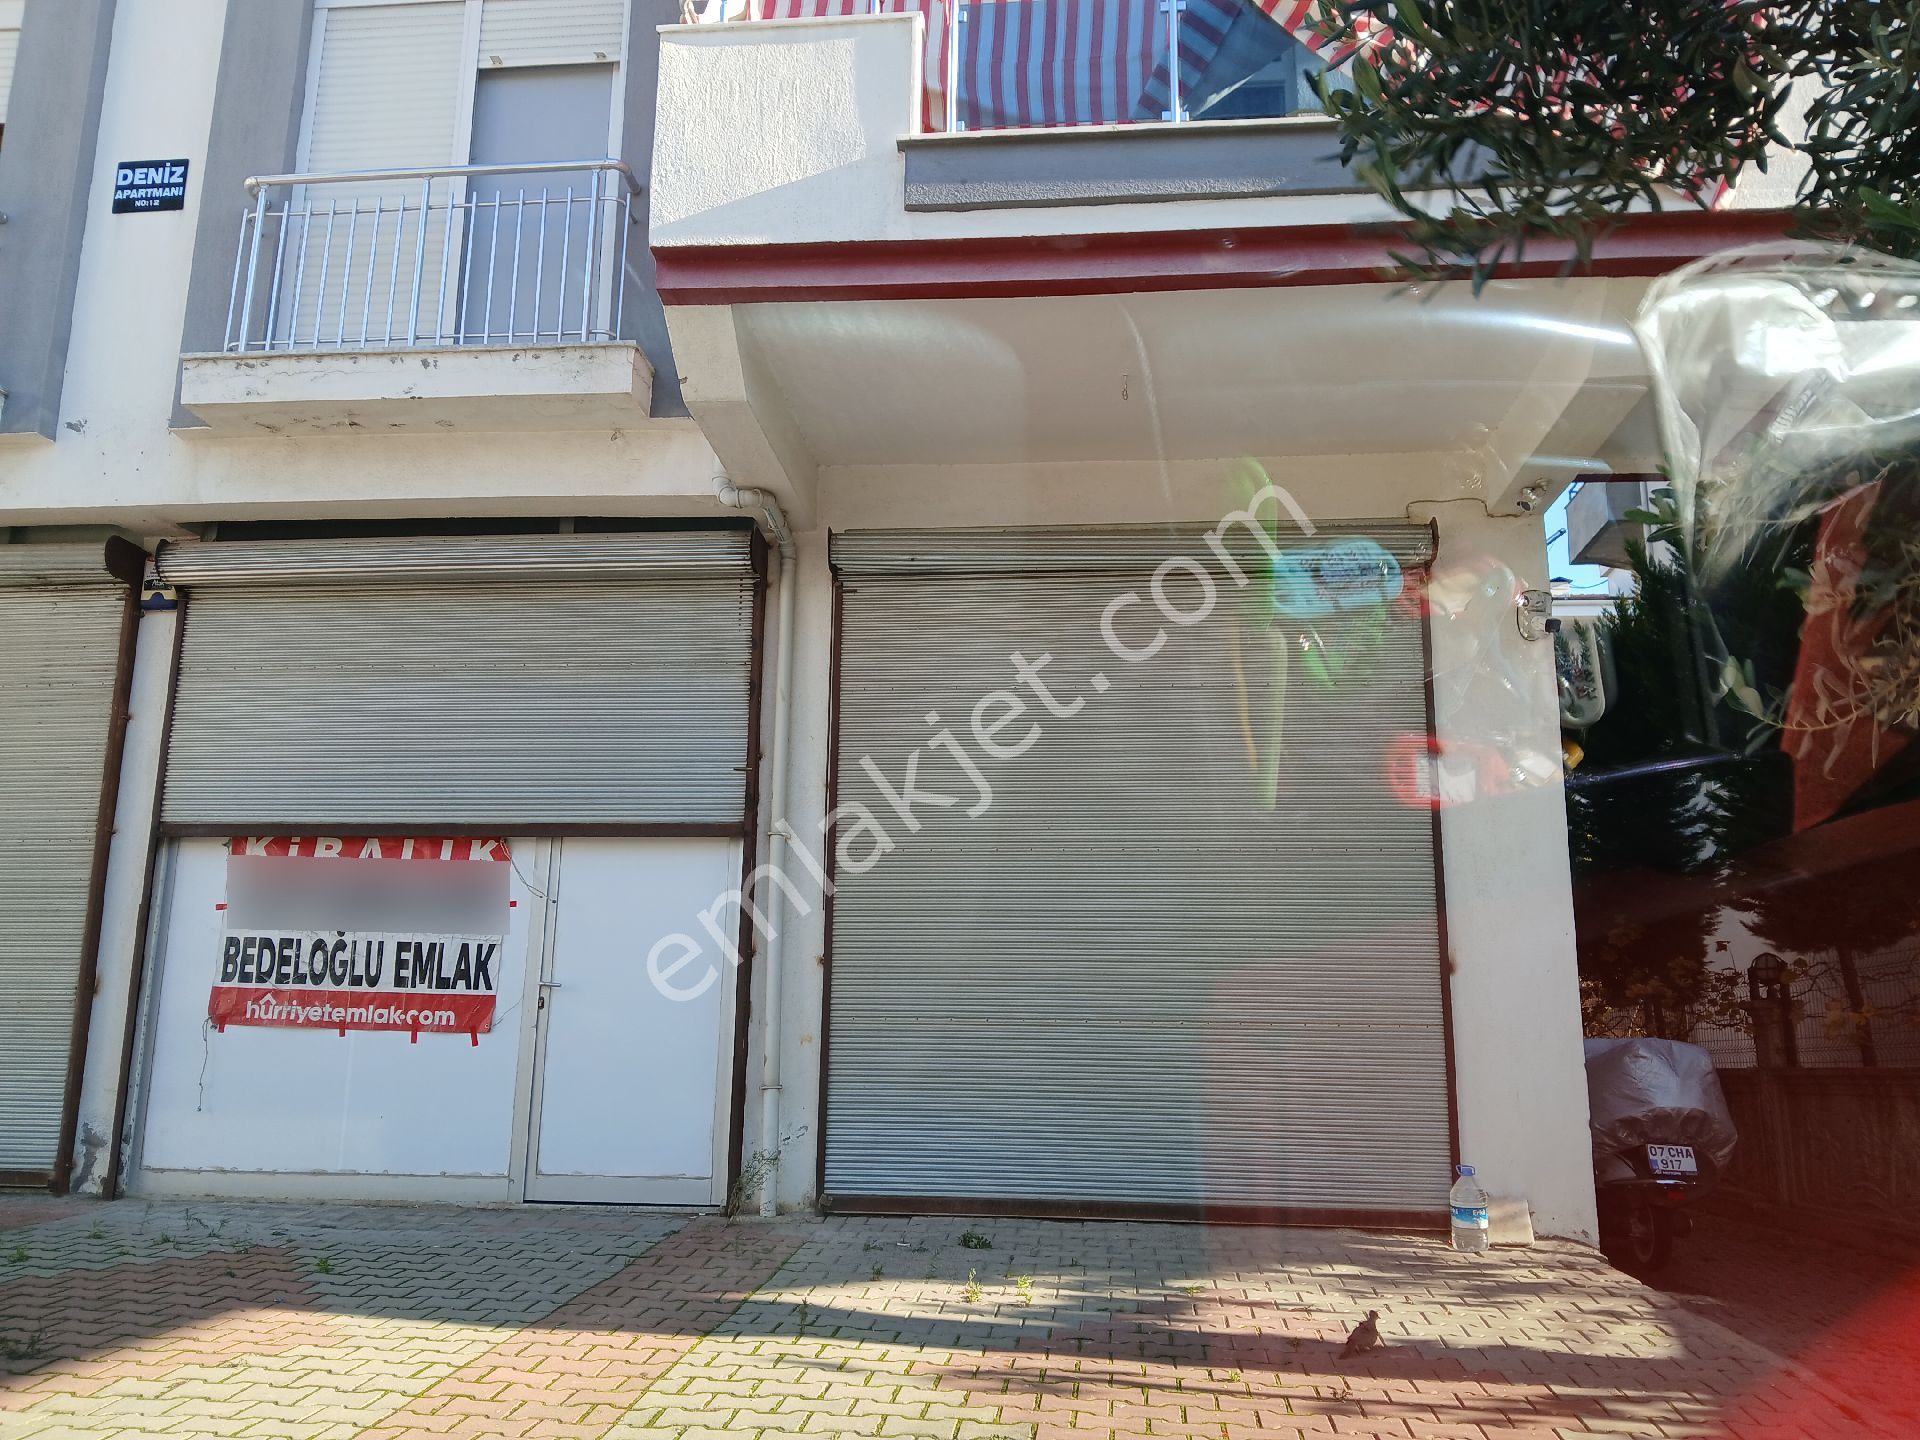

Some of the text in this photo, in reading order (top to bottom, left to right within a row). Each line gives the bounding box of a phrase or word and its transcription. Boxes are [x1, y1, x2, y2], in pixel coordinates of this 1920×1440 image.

[117, 162, 185, 186] DENİZ
[115, 187, 183, 199] APARTMANI
[220, 931, 497, 990] BEDELOĞLU EMLAK
[1649, 1146, 1693, 1159] 07 CHA
[1661, 1159, 1681, 1169] 917
